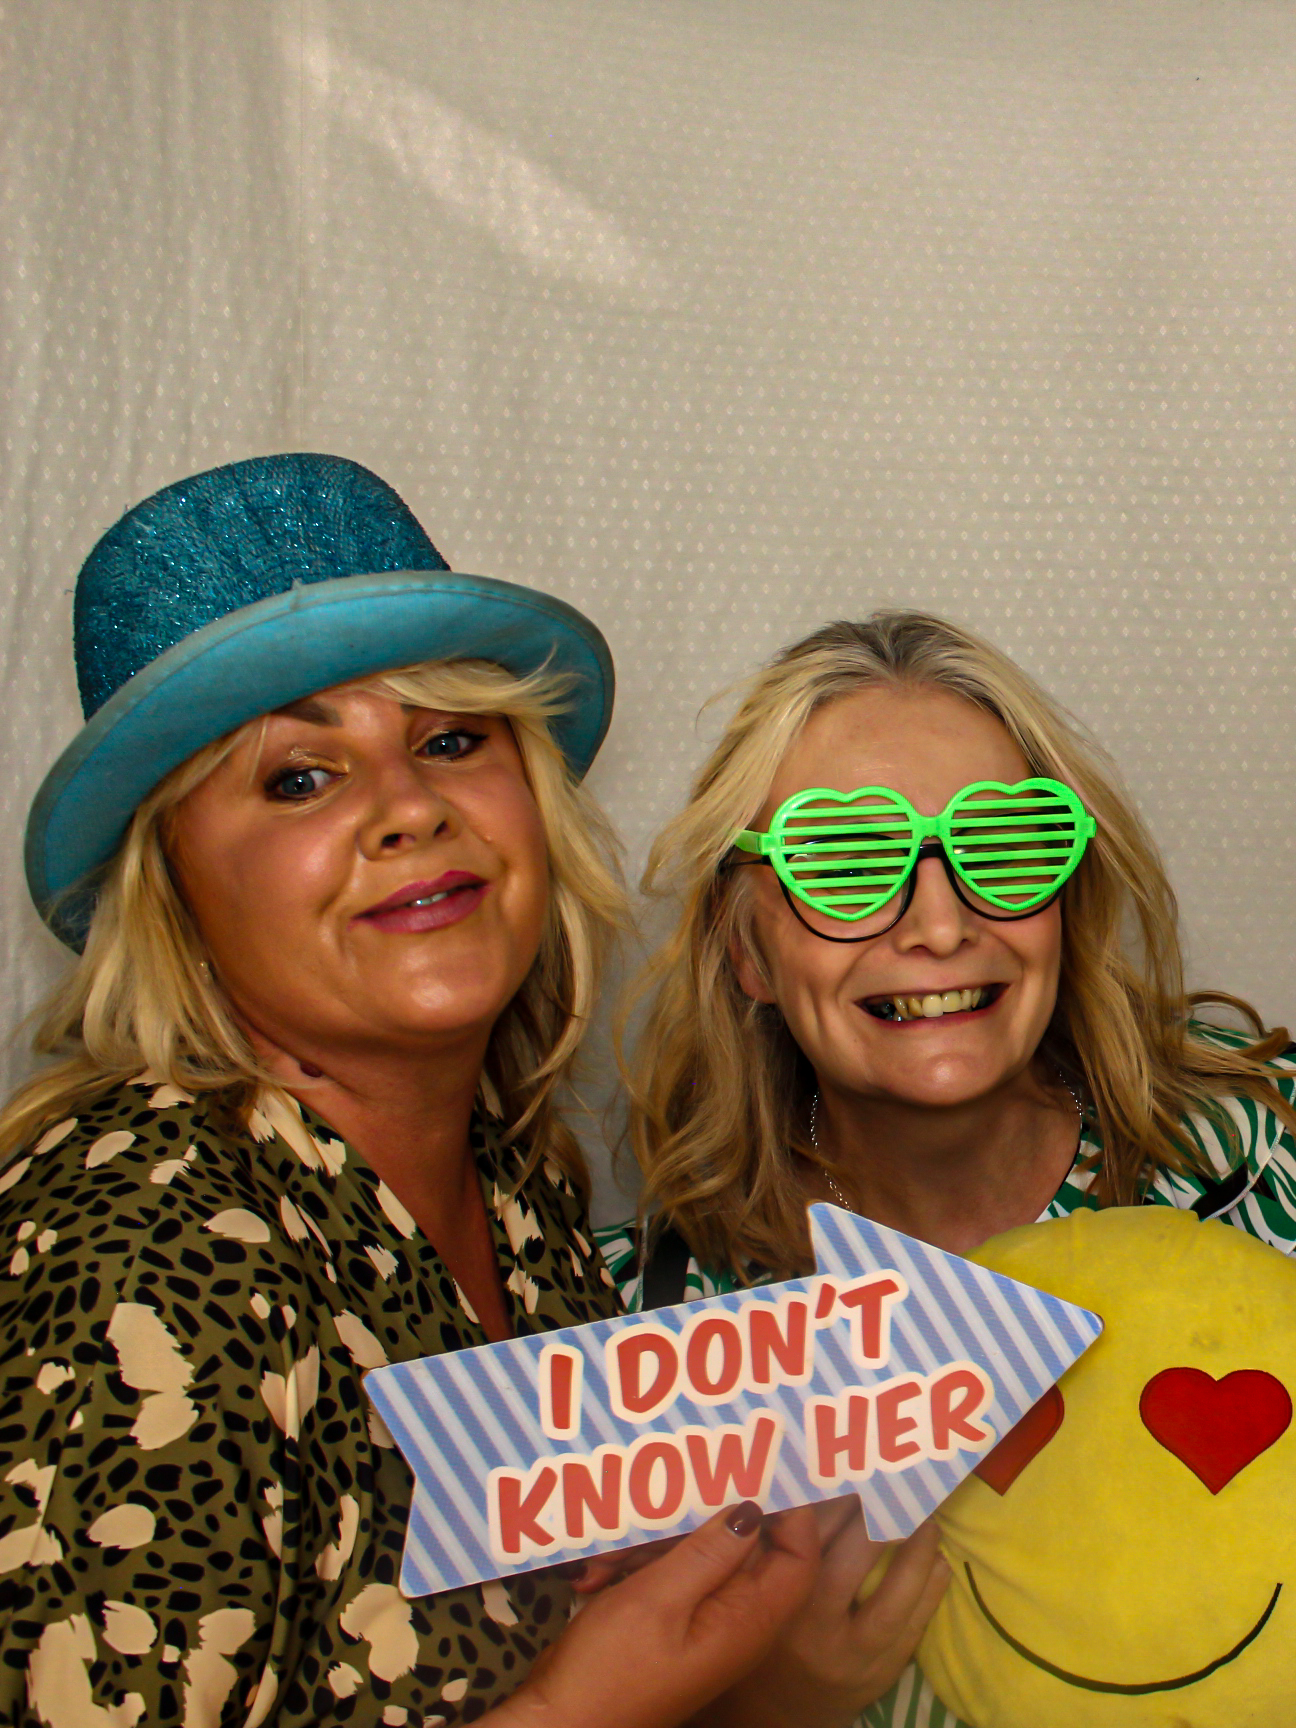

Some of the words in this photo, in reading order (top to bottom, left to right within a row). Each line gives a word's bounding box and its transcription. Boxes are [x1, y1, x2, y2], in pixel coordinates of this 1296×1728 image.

[550, 1353, 575, 1431] I
[615, 1278, 900, 1415] DON'T
[496, 1416, 777, 1555] KNOW
[813, 1369, 988, 1480] HER
